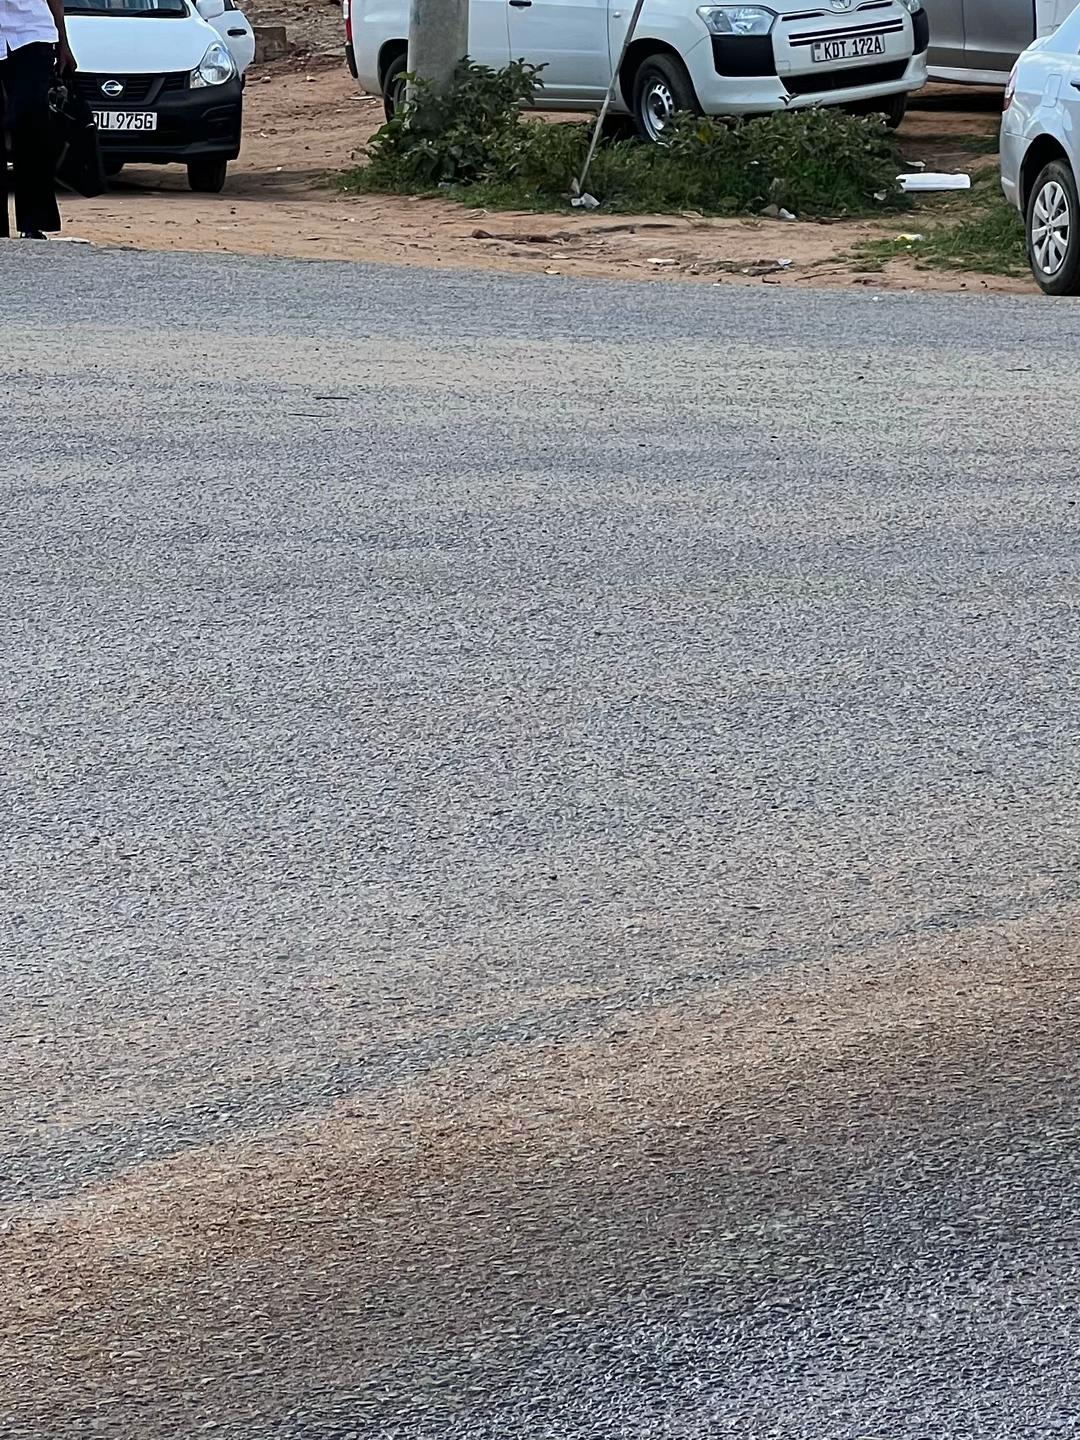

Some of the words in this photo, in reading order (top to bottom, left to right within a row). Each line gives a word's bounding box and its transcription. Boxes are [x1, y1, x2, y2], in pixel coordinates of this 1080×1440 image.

[824, 40, 847, 59] KDT
[852, 35, 882, 56] 172A
[116, 113, 154, 129] 975G
